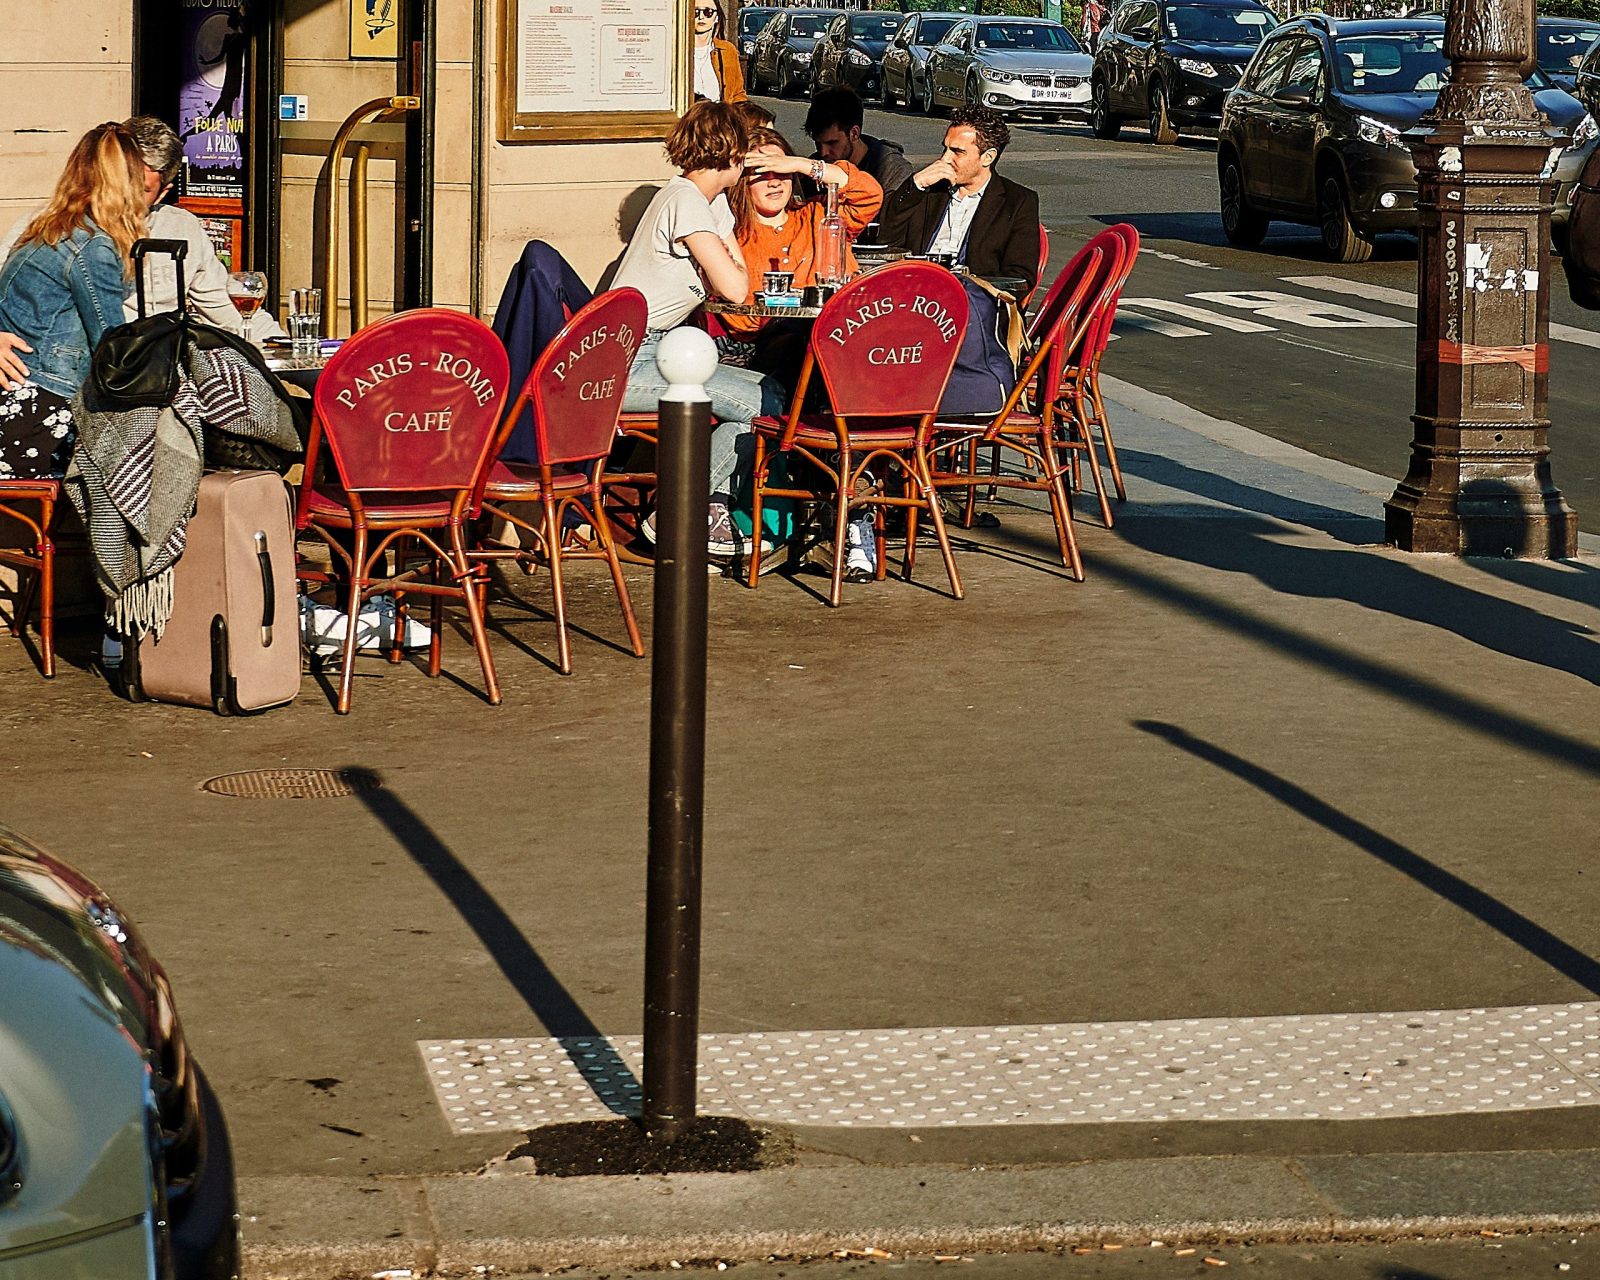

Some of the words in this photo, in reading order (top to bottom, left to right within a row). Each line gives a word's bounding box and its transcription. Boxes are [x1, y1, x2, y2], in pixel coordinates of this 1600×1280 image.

[194, 115, 224, 134] FOLLE
[215, 134, 238, 153] PARIS
[827, 296, 895, 347] PARIS
[911, 294, 957, 344] ROME
[552, 325, 608, 382] PARIS
[868, 341, 924, 365] CAFÉ
[335, 352, 414, 411] PARIS
[433, 351, 496, 408] ROME
[578, 373, 616, 402] CAFÉ
[383, 406, 453, 433] CAFÉ
